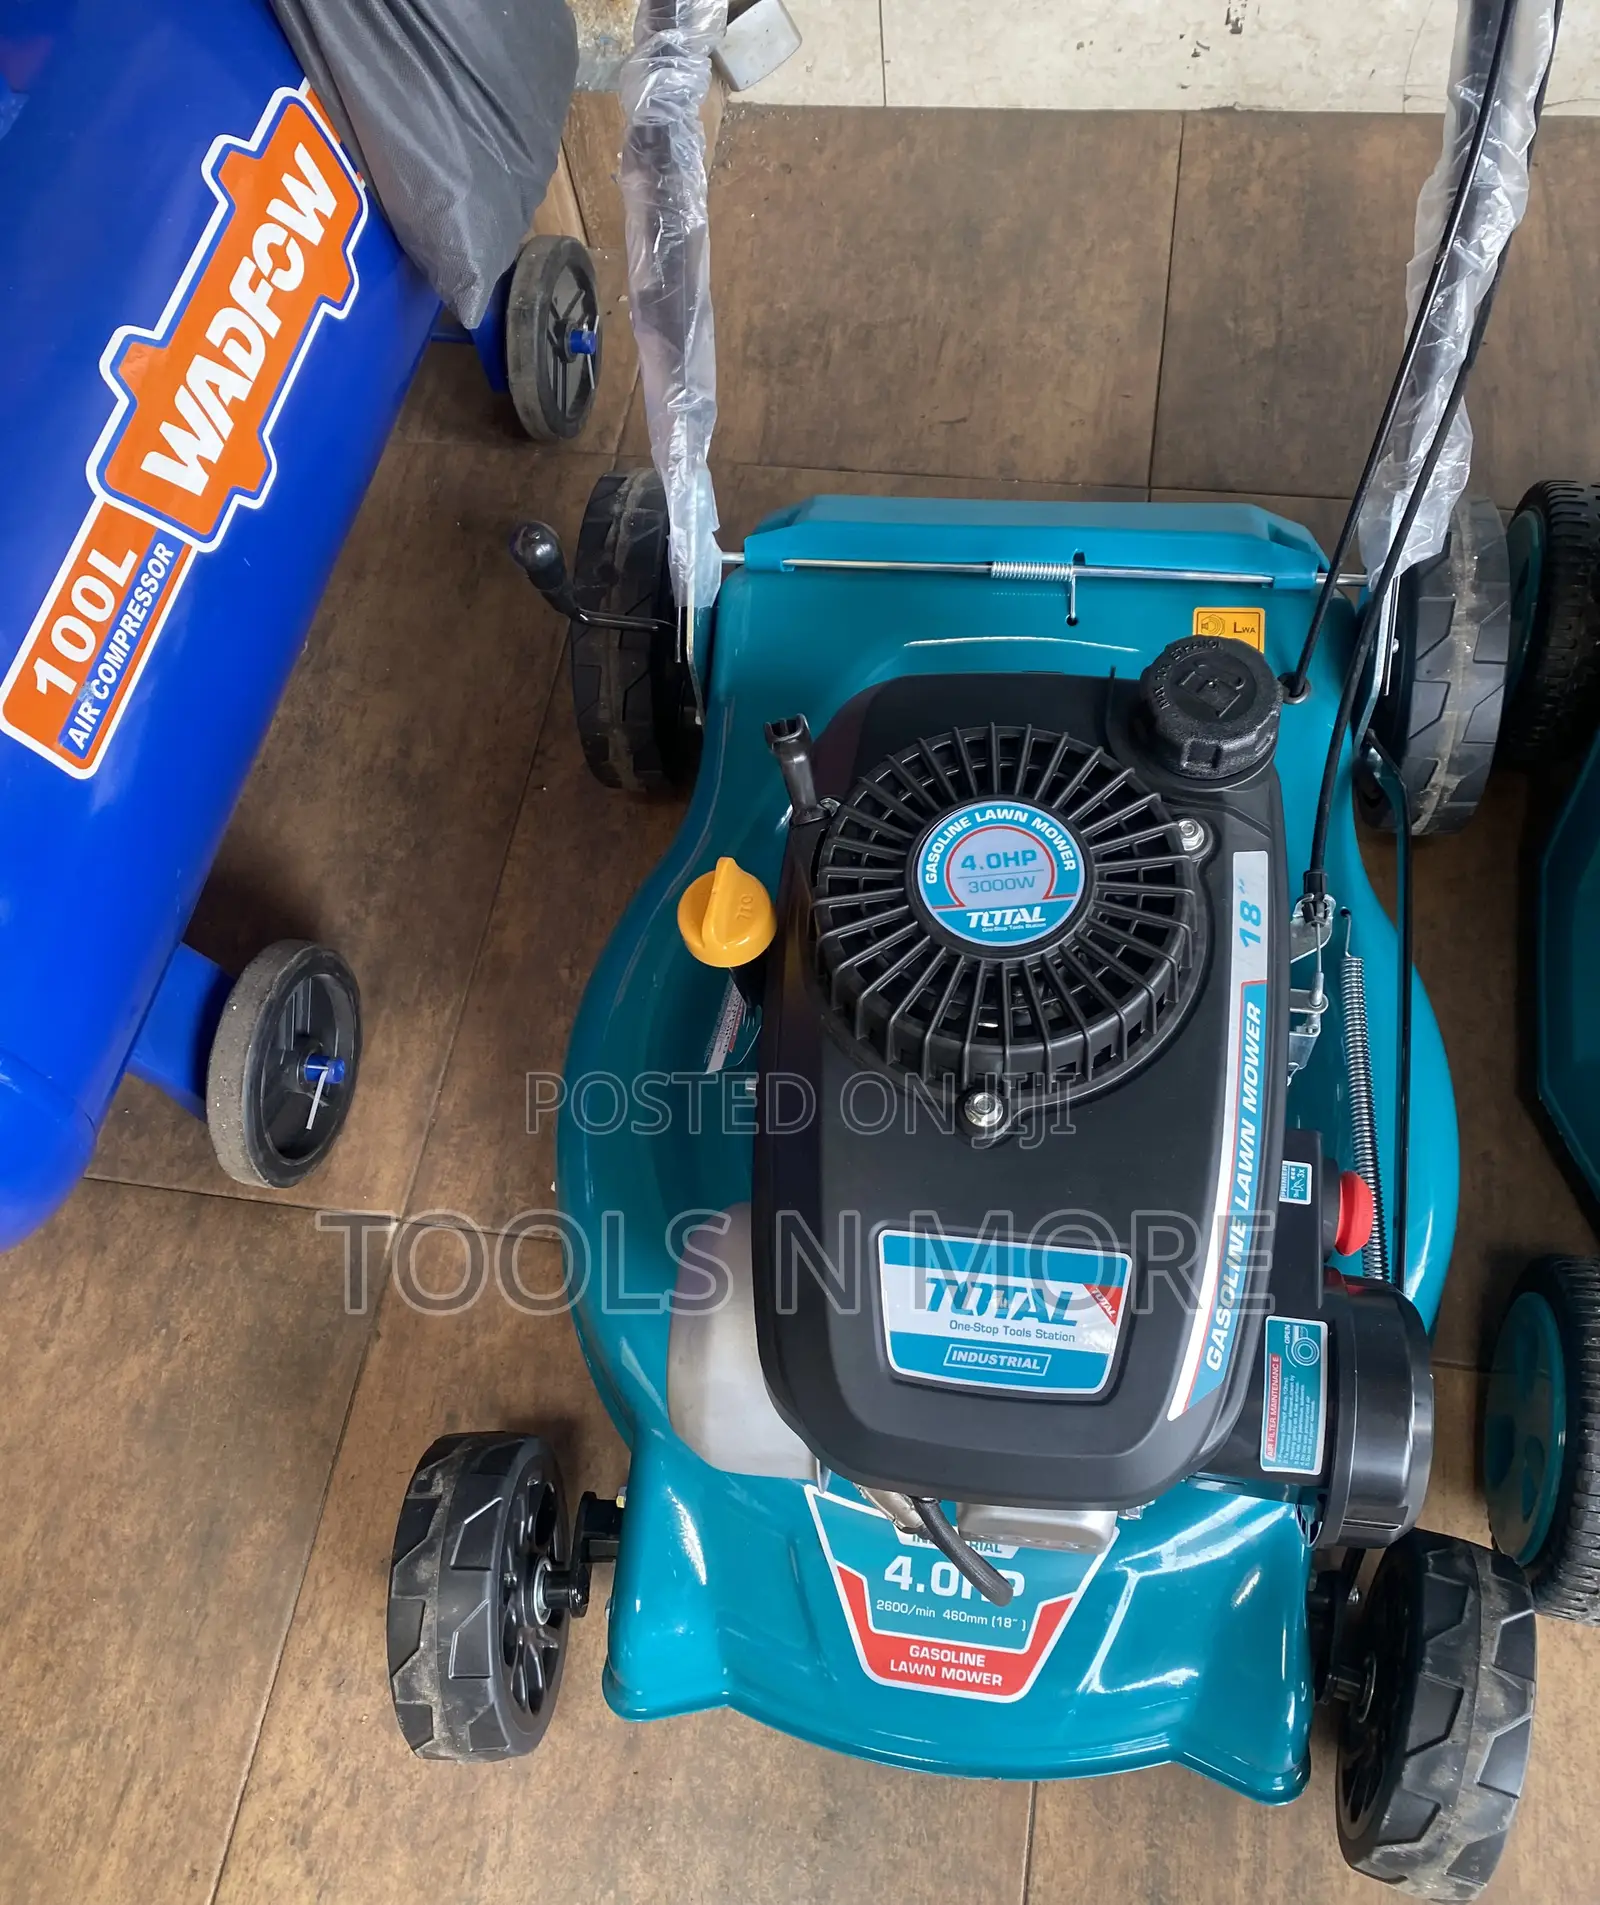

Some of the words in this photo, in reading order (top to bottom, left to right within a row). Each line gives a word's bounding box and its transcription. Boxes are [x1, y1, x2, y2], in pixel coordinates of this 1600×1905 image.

[33, 549, 138, 695] 100L
[67, 701, 101, 750] AIR
[92, 542, 174, 700] COMPRESSOR
[925, 816, 972, 884] GASOLINE
[974, 808, 1029, 823] LAWN
[1031, 817, 1076, 872] MOWER
[961, 850, 1037, 871] 4.0HP
[968, 875, 1036, 894] 3000W
[966, 906, 1046, 928] TOTAL
[1242, 1001, 1261, 1114] MOWER
[1234, 1117, 1256, 1211] LAWN
[925, 1277, 1078, 1326] TOTAL
[1091, 1287, 1116, 1317] TOTAL
[1206, 1215, 1247, 1371] GASOLINE
[950, 1320, 999, 1336] One-Stop
[1003, 1325, 1031, 1338] Tools
[1035, 1329, 1076, 1343] Station
[952, 1350, 1041, 1370] INDUSTRIAL
[876, 1600, 936, 1618] 2600/min
[942, 1609, 988, 1625] 460mm
[909, 1645, 986, 1668] GASOLINE
[890, 1659, 936, 1678] LAWN
[941, 1668, 1003, 1687] MOWER
